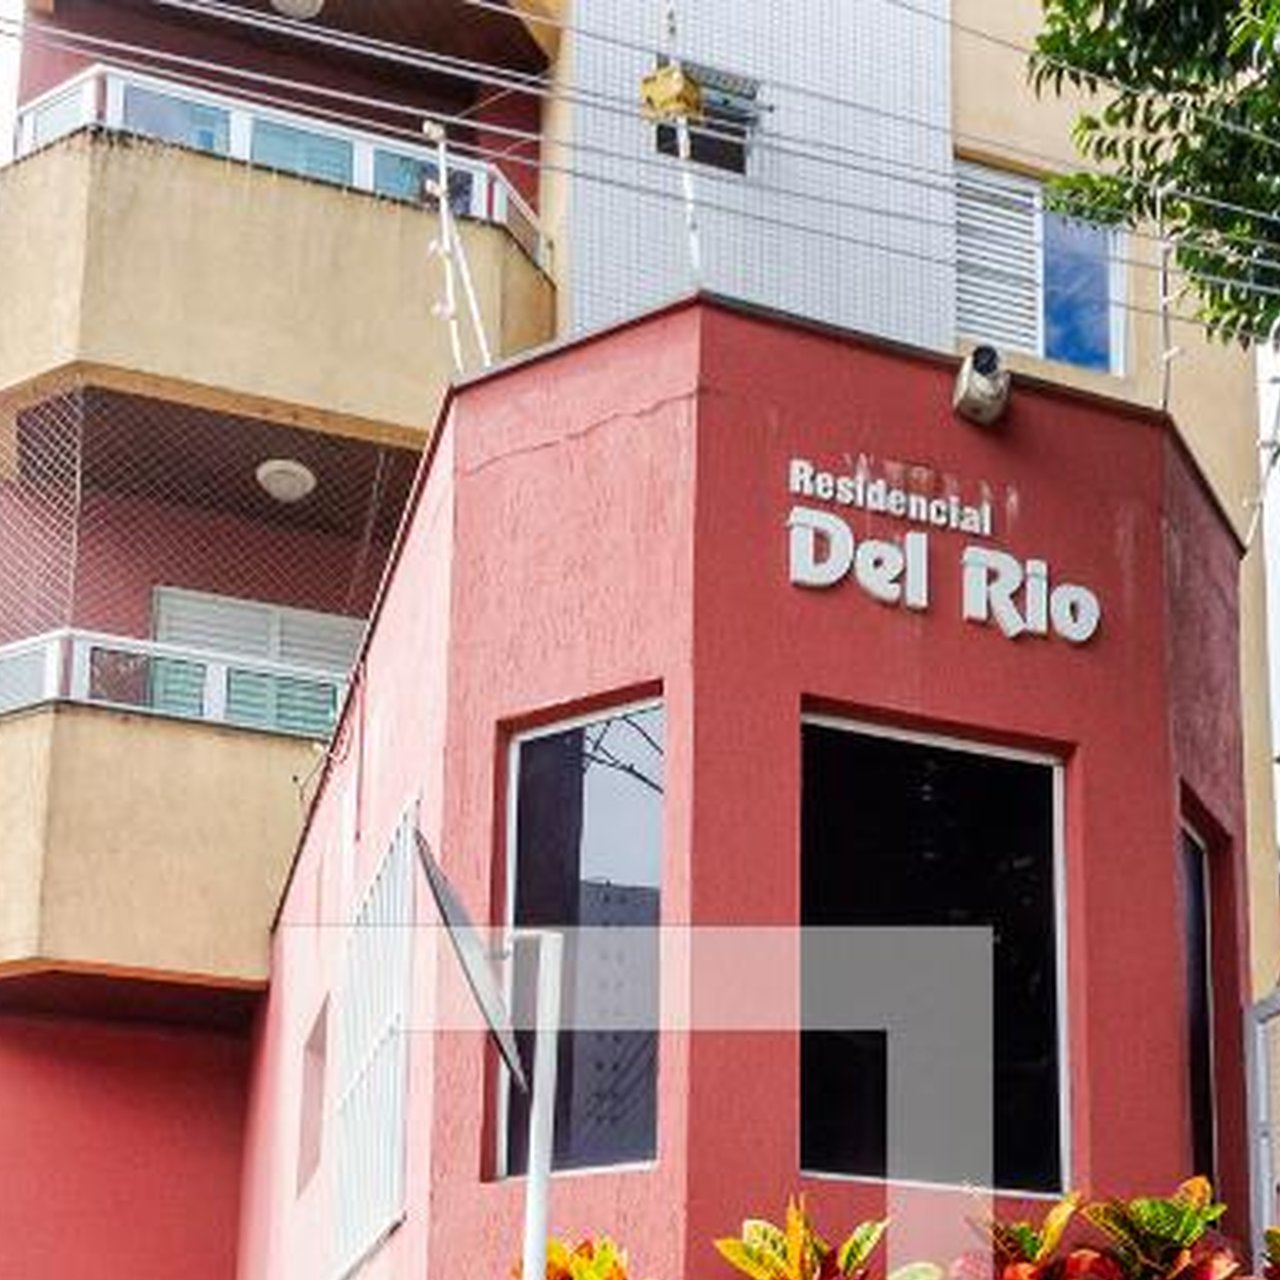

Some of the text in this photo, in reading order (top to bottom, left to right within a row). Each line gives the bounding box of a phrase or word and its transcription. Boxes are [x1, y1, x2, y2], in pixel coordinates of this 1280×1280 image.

[789, 458, 992, 536] Residencial
[787, 505, 1102, 643] Del Rio
